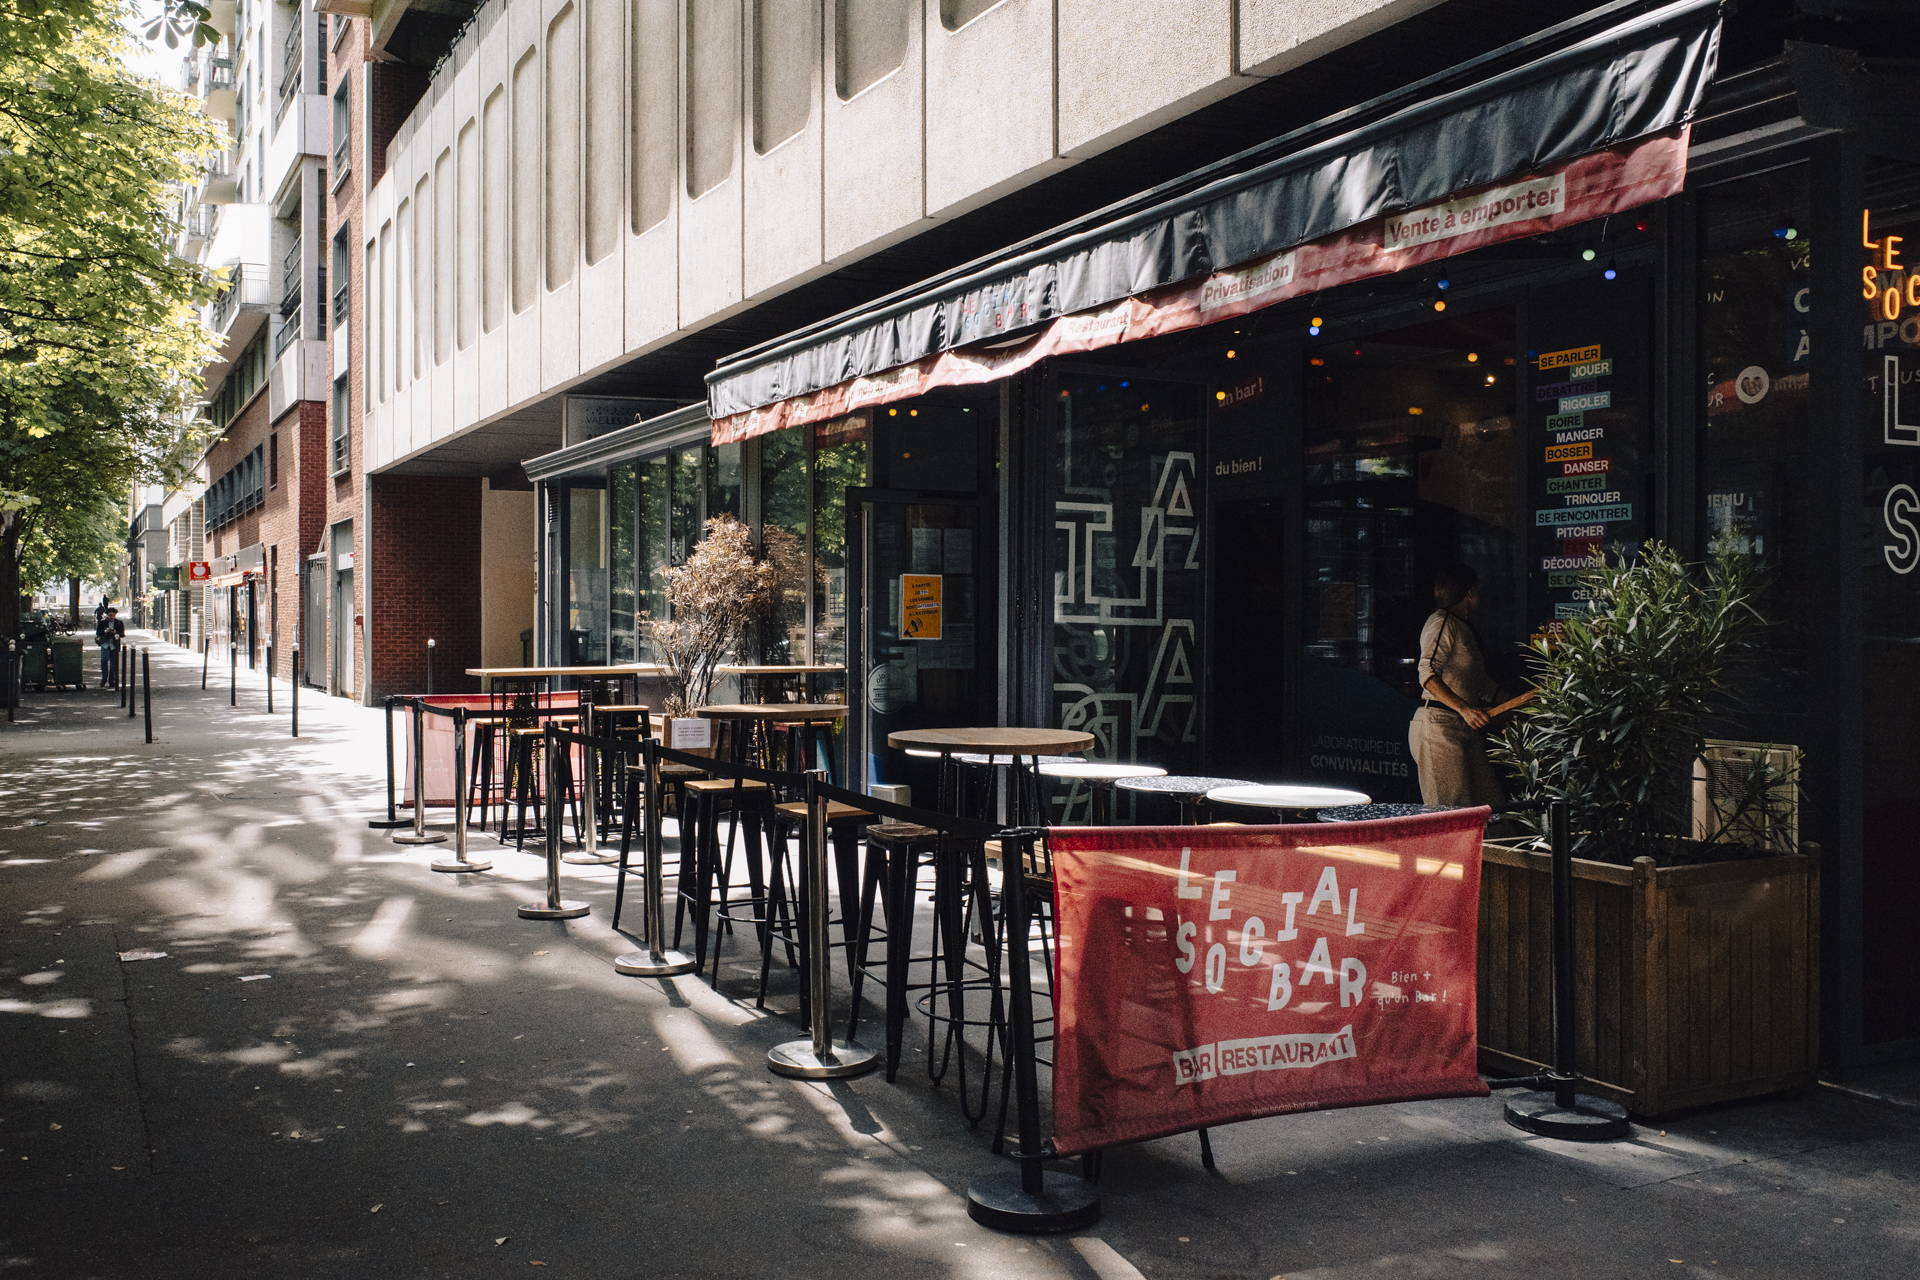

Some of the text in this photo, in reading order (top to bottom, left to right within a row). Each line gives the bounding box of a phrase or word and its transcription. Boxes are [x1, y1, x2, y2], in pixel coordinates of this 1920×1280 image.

[1389, 186, 1560, 242] Vente à emporter
[1862, 208, 1904, 270] LE
[1204, 264, 1290, 303] Privatisation
[962, 299, 976, 314] LE
[1067, 311, 1129, 333] Restaurant
[1541, 348, 1598, 367] SE PARLER
[1571, 361, 1609, 378] JOUER
[1235, 385, 1257, 401] bar
[1538, 381, 1595, 399] DÉBATTRE
[1560, 395, 1608, 411] RIGOLER
[1549, 415, 1581, 429] BOIRE
[1556, 428, 1604, 444] MANGER
[1547, 446, 1590, 460] BOSSER
[1215, 461, 1230, 476] du
[1231, 458, 1257, 473] bien
[1564, 460, 1609, 475] DANSER
[1548, 478, 1602, 492] CHANTER
[1564, 491, 1621, 506] TRINQUER
[1538, 507, 1629, 523] SE RENCONTRER
[1556, 525, 1604, 539] PITCHER
[1543, 556, 1606, 570] DÉCOUVRI
[1549, 575, 1563, 586] SE
[1386, 741, 1401, 755] DE
[1310, 754, 1409, 778] CONVIVIALITÉS
[1177, 846, 1237, 921] LE
[1267, 936, 1367, 1012] BAR
[1391, 971, 1418, 984] Bien
[1178, 1033, 1349, 1079] BAR RESTAURANT
